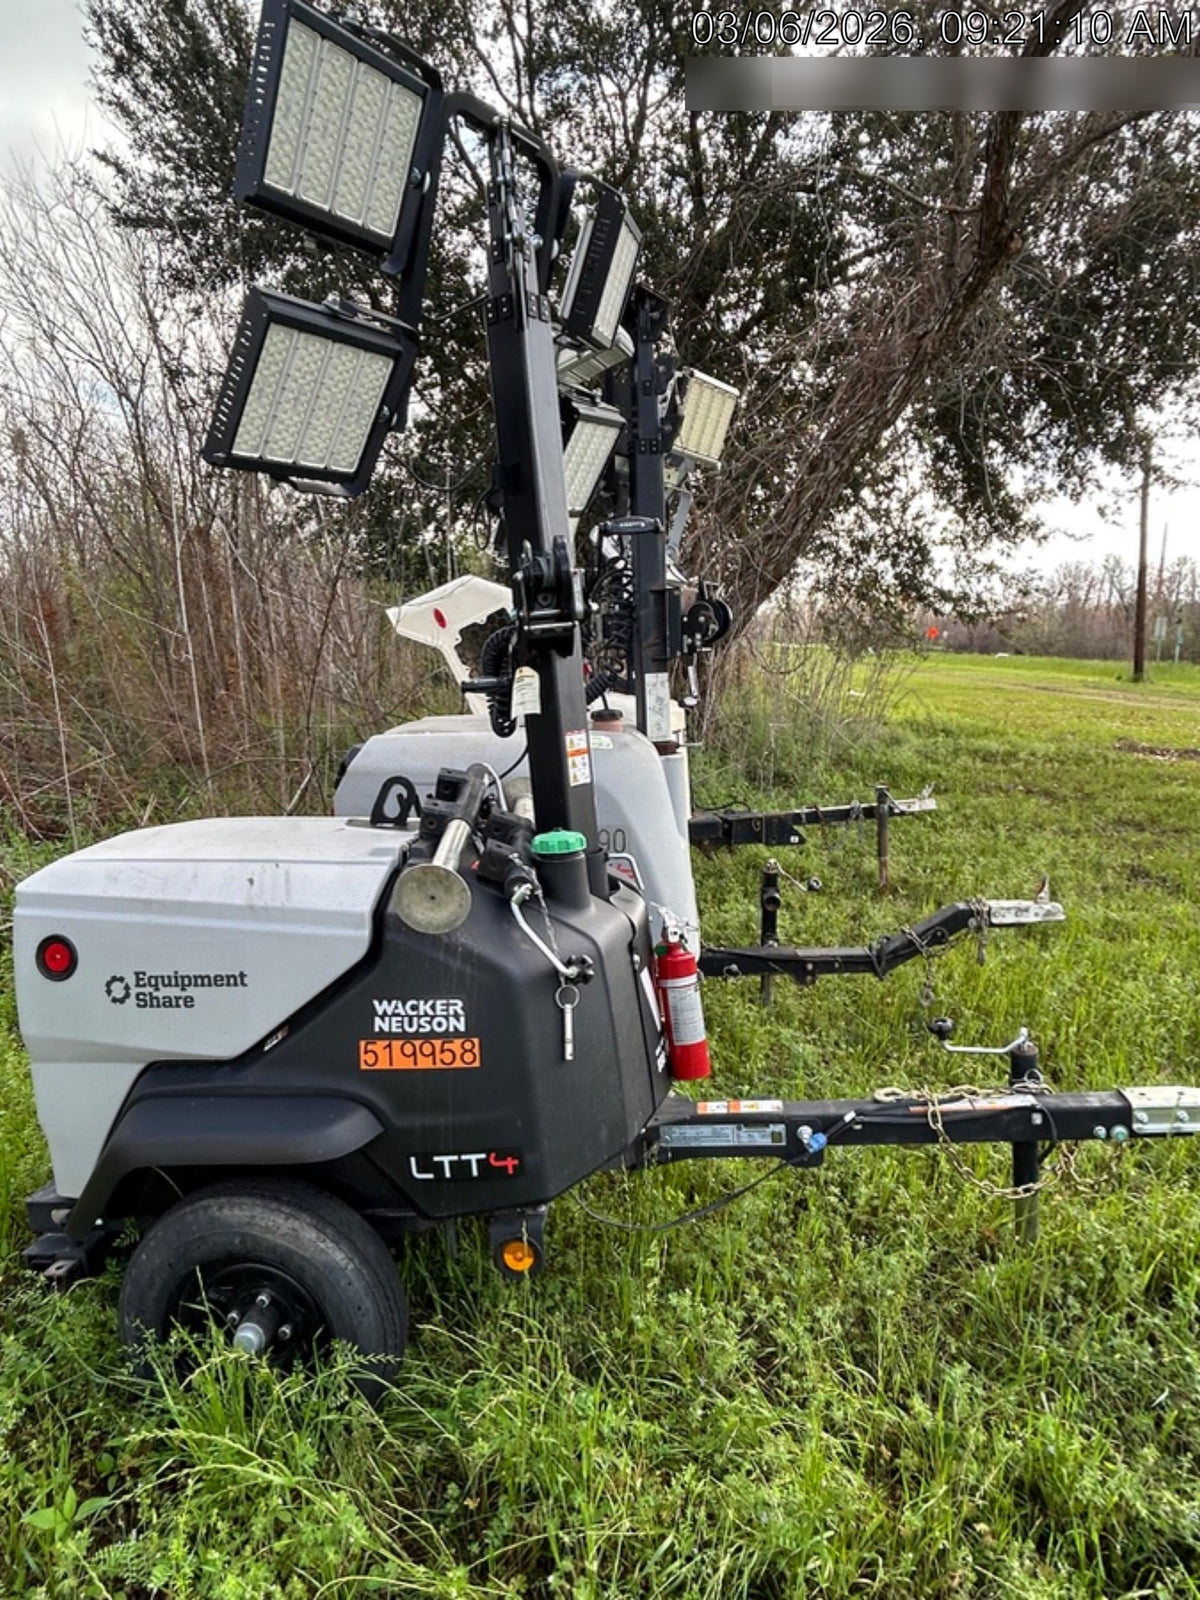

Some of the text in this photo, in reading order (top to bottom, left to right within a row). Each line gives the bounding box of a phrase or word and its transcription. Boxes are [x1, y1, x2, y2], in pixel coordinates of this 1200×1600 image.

[133, 970, 248, 992] Equipment
[135, 991, 196, 1009] Share
[372, 999, 466, 1016] WACKER
[373, 1015, 467, 1033] NEUSON
[362, 1038, 479, 1068] 519958
[409, 1151, 520, 1180] LTT4
